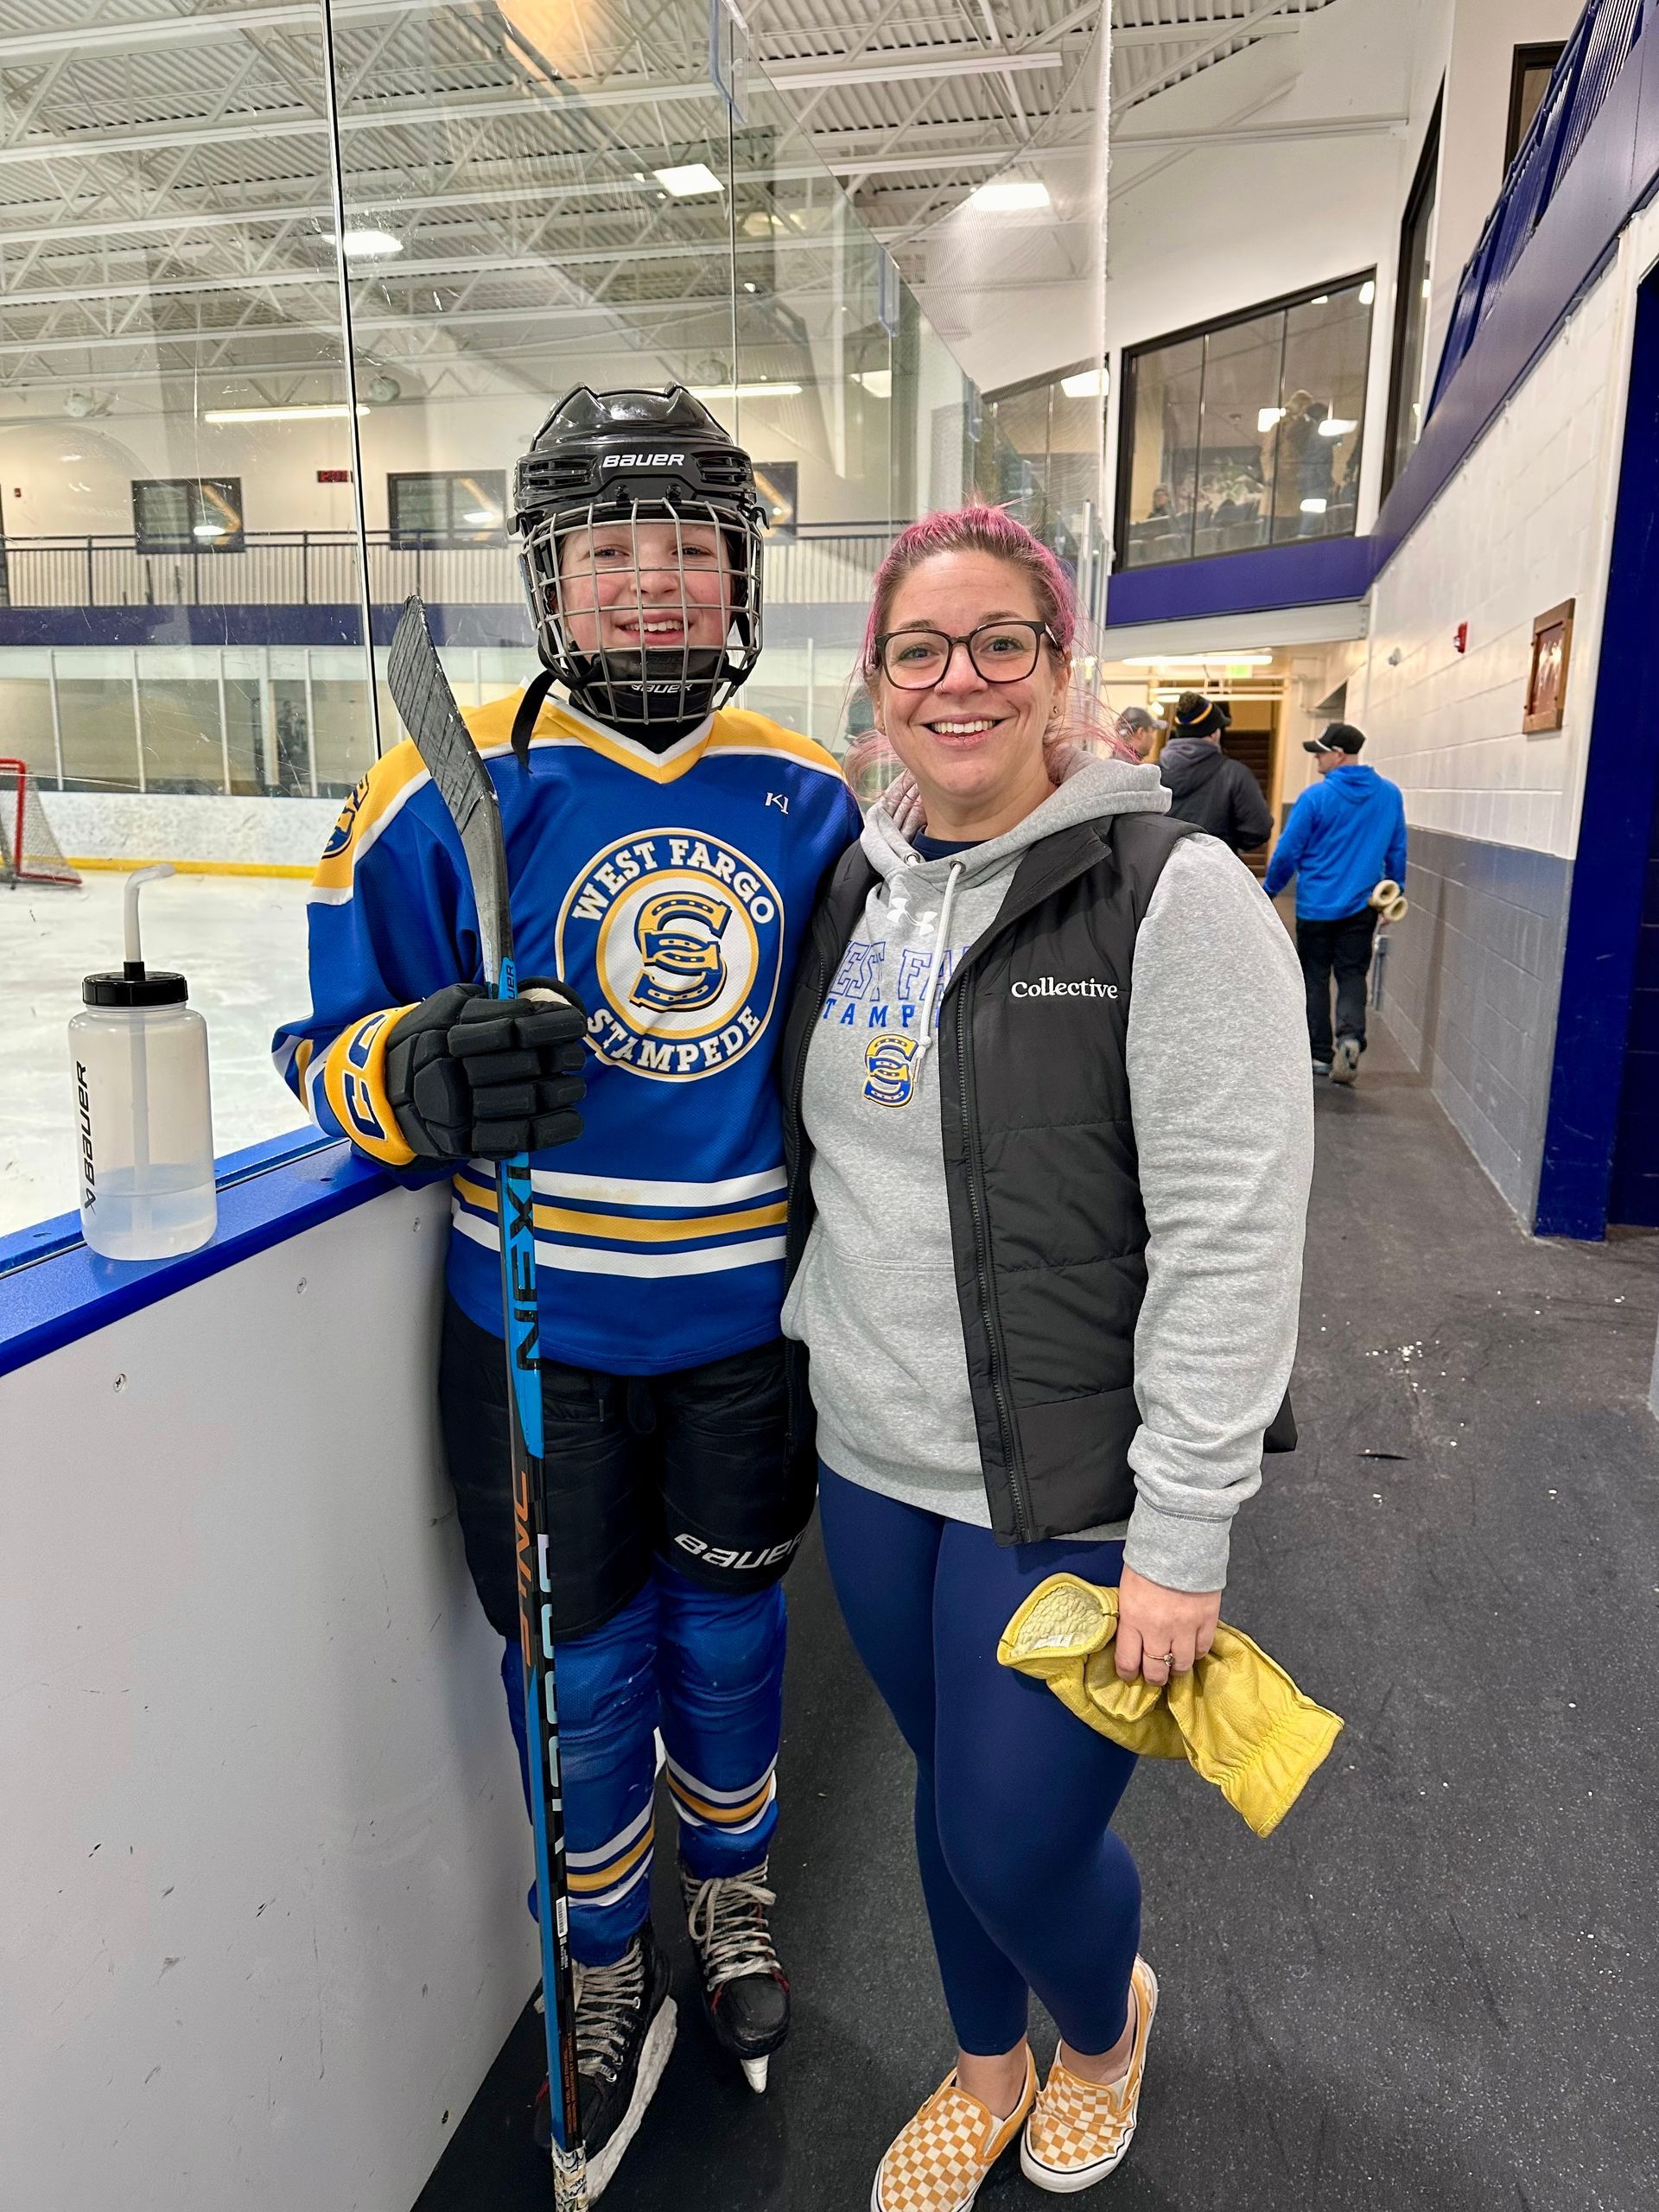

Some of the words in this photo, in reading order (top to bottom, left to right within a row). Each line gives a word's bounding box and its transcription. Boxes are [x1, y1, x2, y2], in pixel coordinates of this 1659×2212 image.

[602, 454, 684, 468] BAUER
[572, 842, 658, 922] WEST
[669, 839, 774, 924] FARGO
[1011, 977, 1118, 999] Collective
[588, 1005, 760, 1072] STAMPEDE
[77, 1061, 95, 1186] BAUER
[674, 1533, 806, 1569] BAUER
